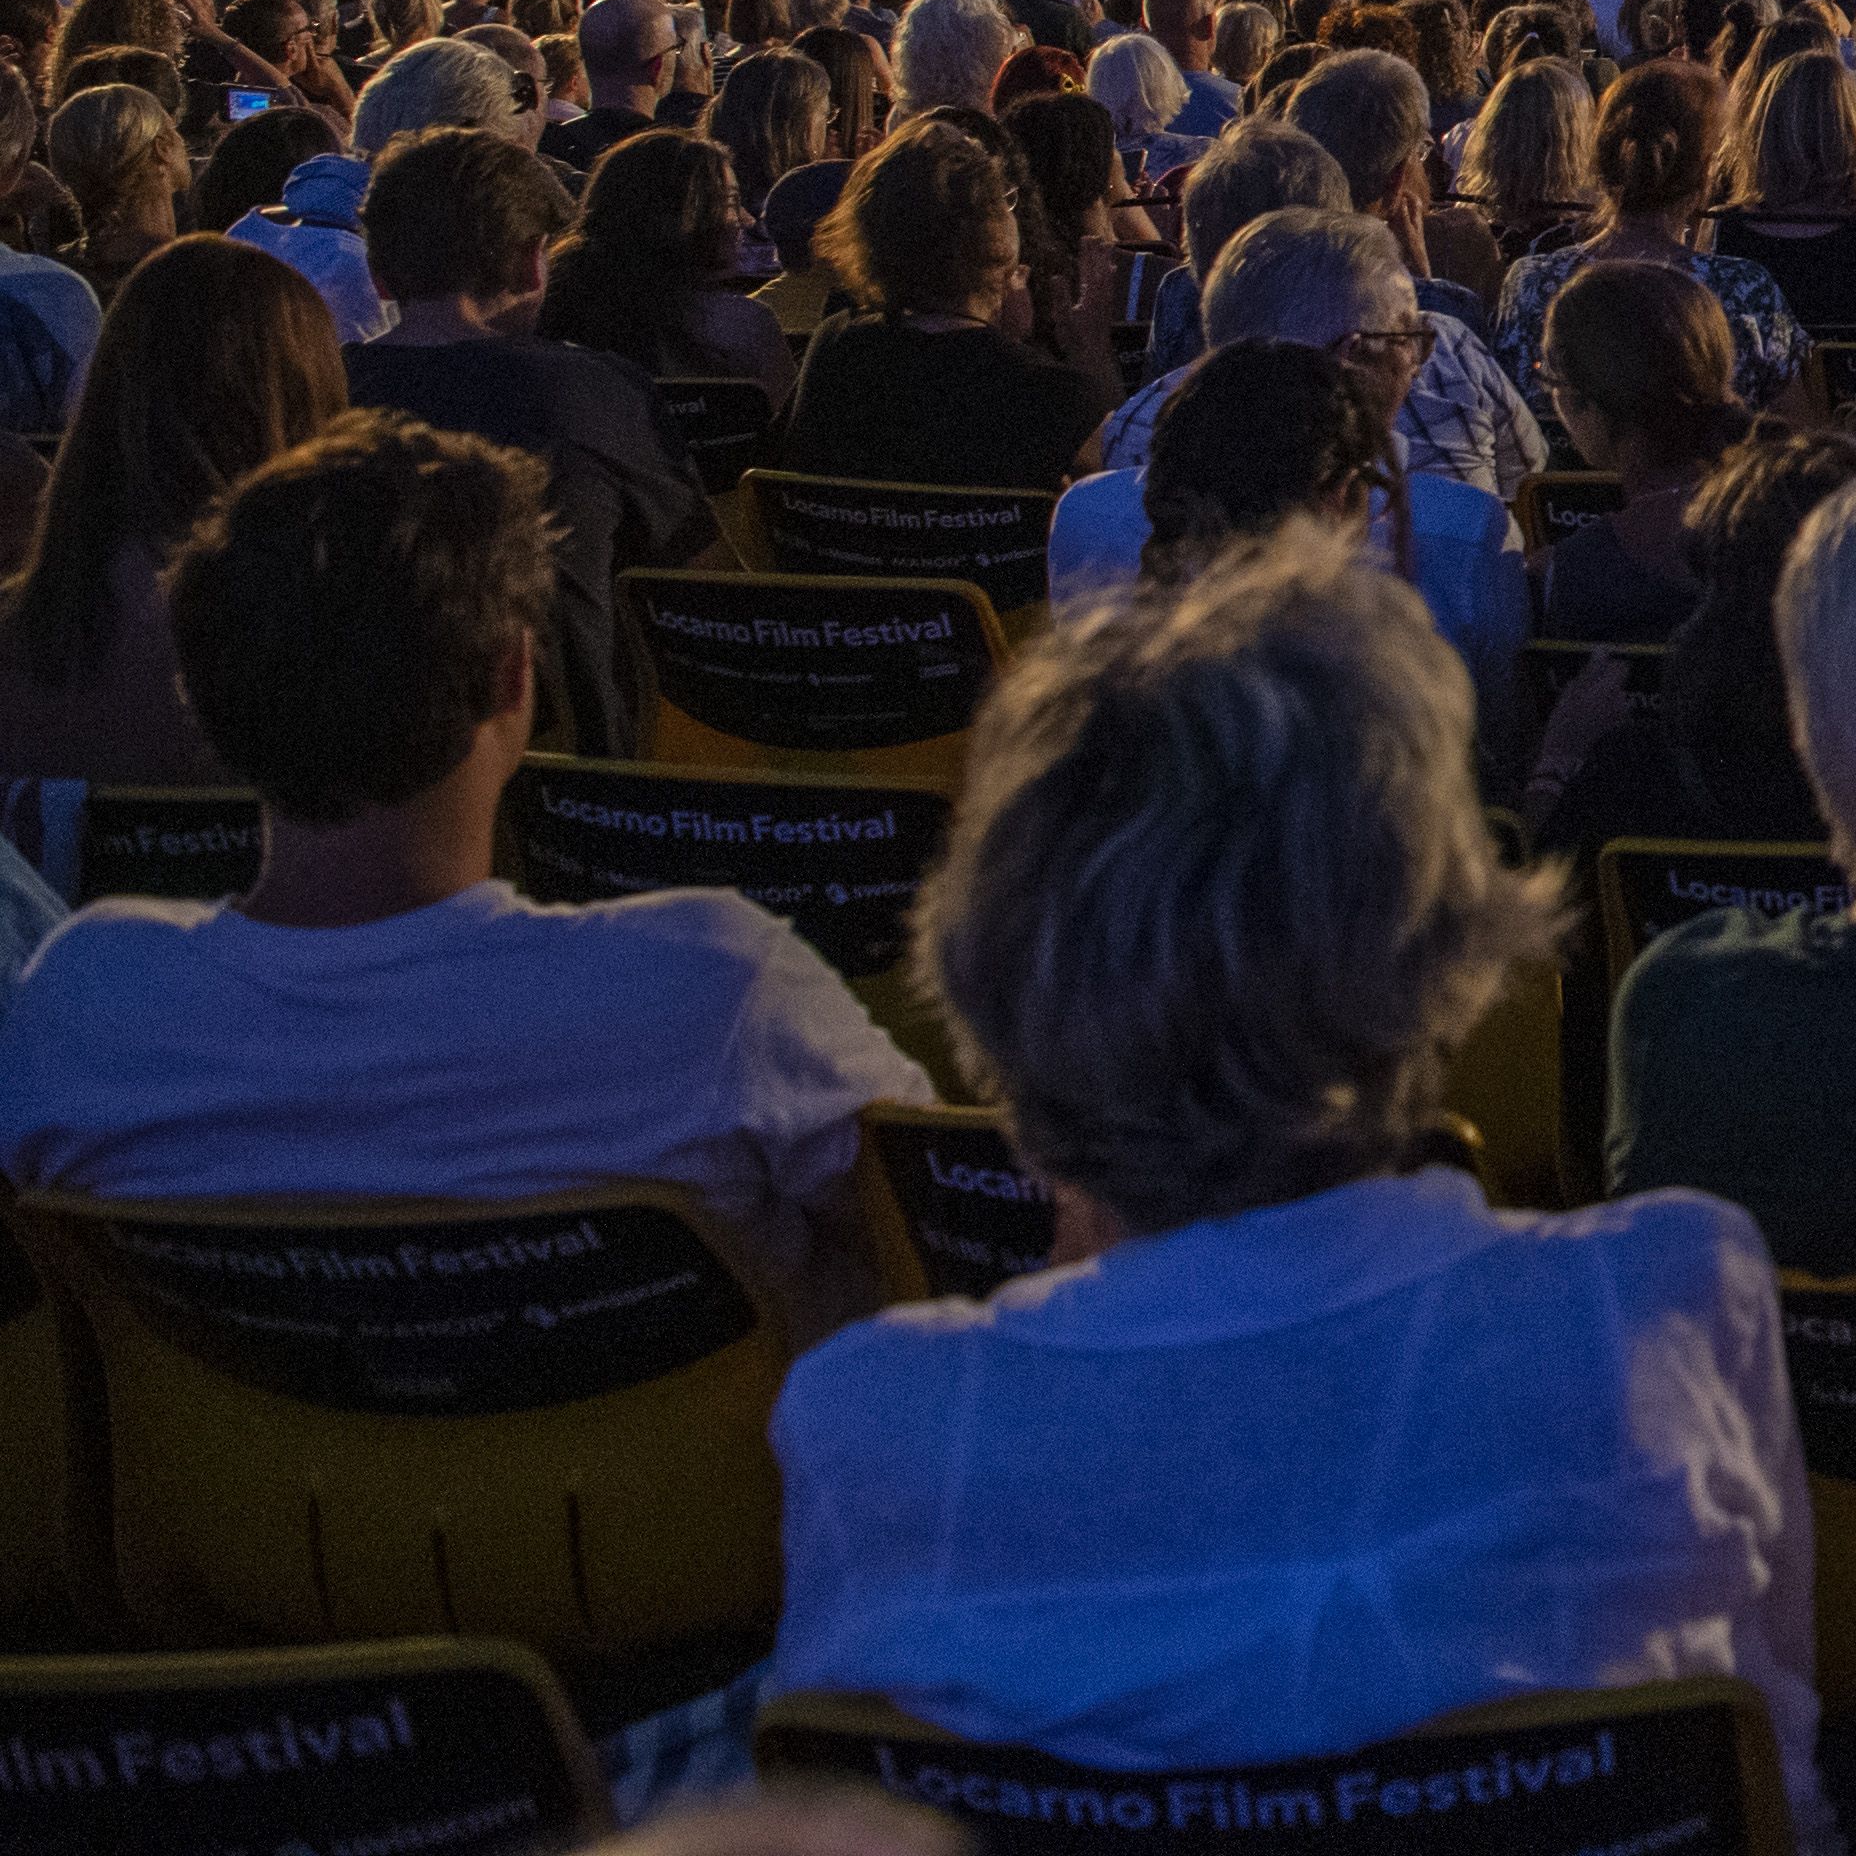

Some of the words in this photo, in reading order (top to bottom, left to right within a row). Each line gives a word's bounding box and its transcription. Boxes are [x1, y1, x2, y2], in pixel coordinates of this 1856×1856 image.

[782, 492, 868, 525] Locarno
[869, 506, 921, 529] Film
[923, 505, 1021, 530] Festival
[646, 598, 751, 643] Locarno
[753, 618, 820, 647] Film
[822, 612, 953, 647] Festival
[541, 784, 667, 837] Locarno
[670, 809, 750, 843] Film
[751, 809, 897, 844] Festival
[1668, 869, 1809, 912] Locarno
[926, 1150, 1049, 1202] Locarn
[288, 1244, 396, 1280] Film
[399, 1221, 604, 1278] Festival
[112, 1694, 415, 1787] Festival
[874, 1743, 1156, 1833] Locarno
[1164, 1779, 1328, 1833] Film
[1335, 1730, 1619, 1824] Festival
